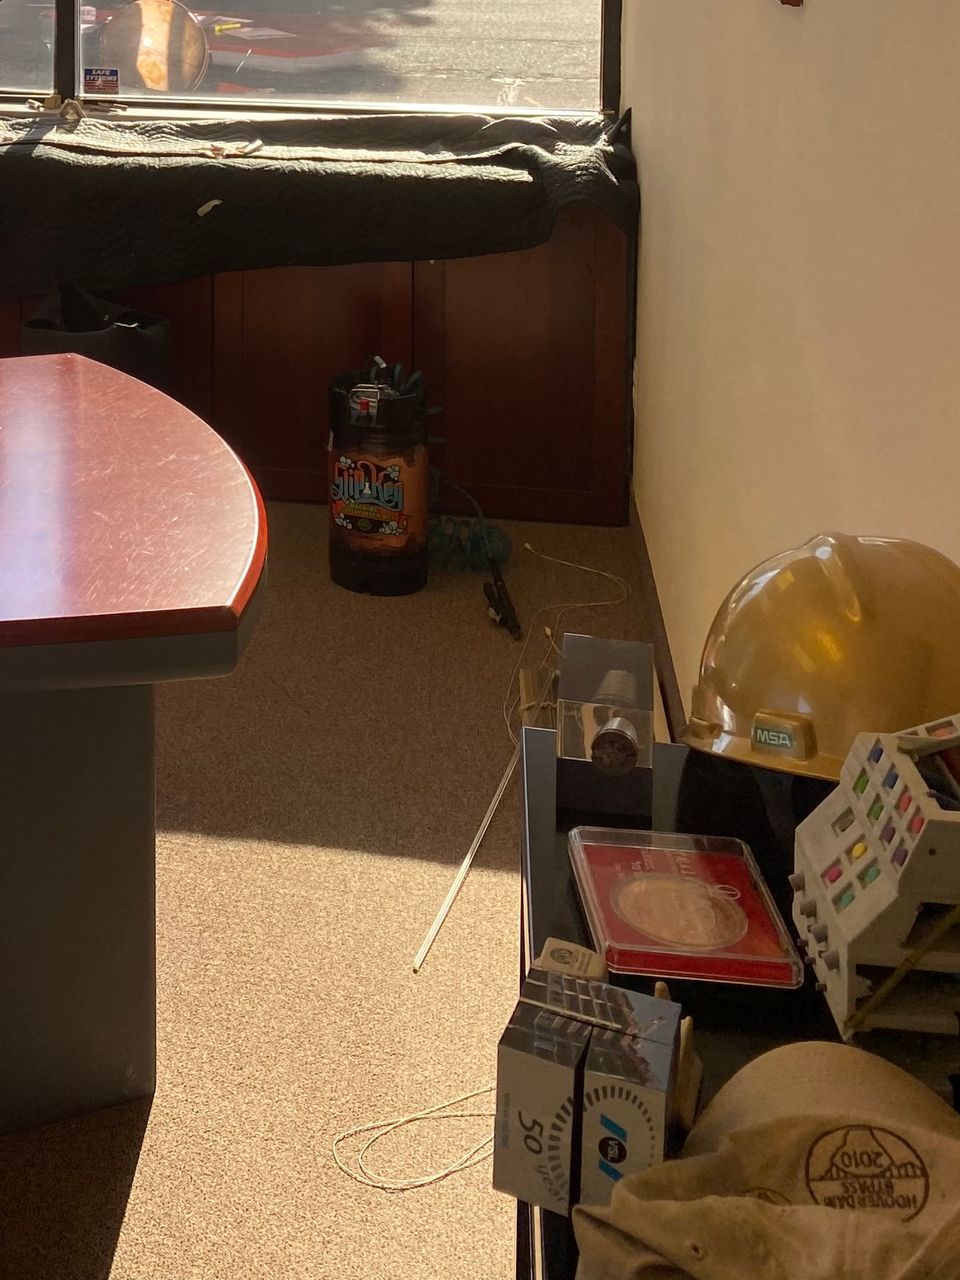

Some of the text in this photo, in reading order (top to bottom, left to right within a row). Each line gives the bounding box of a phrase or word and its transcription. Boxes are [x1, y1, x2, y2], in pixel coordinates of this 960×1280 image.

[756, 729, 791, 748] MSA
[518, 1110, 545, 1156] 50
[607, 1140, 619, 1161] VSL
[841, 1150, 883, 1169] 2010
[841, 1180, 894, 1196] BYPASS
[857, 1194, 918, 1209] HOOVER
